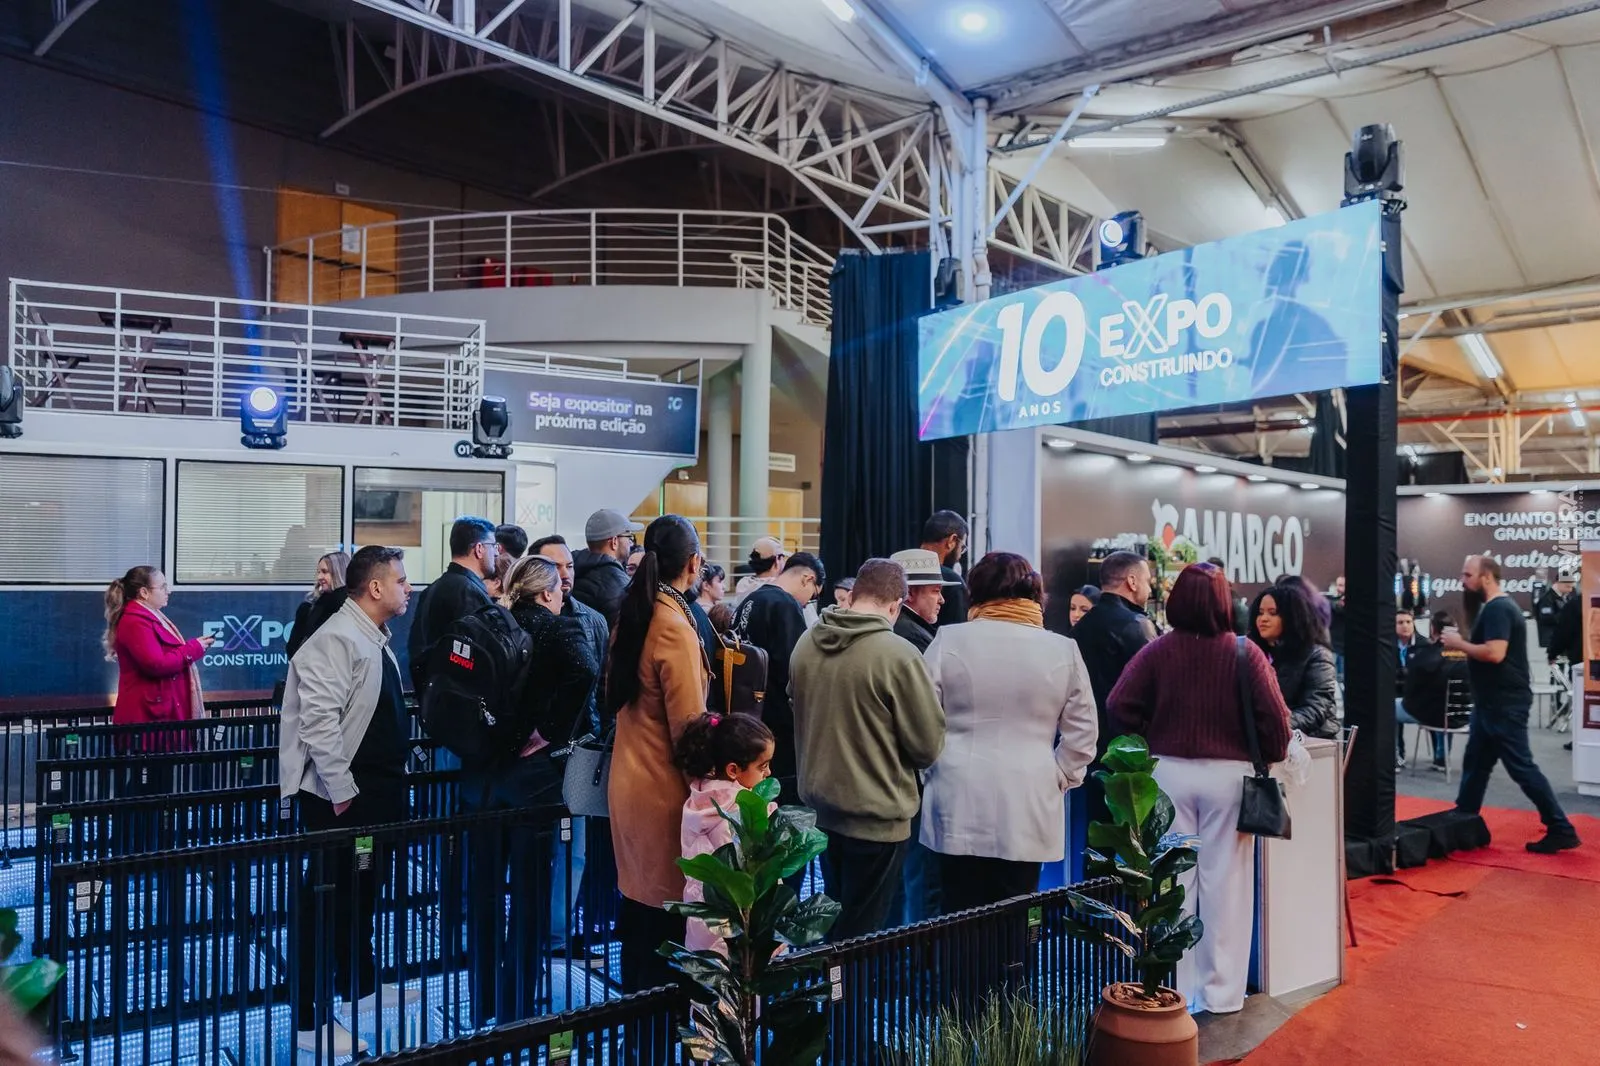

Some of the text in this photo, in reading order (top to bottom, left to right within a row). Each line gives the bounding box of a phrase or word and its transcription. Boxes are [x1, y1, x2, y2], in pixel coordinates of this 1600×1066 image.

[1100, 292, 1232, 359] EXPO
[997, 292, 1085, 402] 10
[1100, 347, 1232, 387] CONSTRUINDO
[529, 391, 653, 417] Seja expositor na
[1019, 400, 1062, 418] ANOS
[535, 412, 647, 435] próxima edição
[1464, 511, 1556, 526] ENQUANTO
[1152, 498, 1304, 584] CAMARGO
[203, 653, 289, 666] CONSTRUIN
